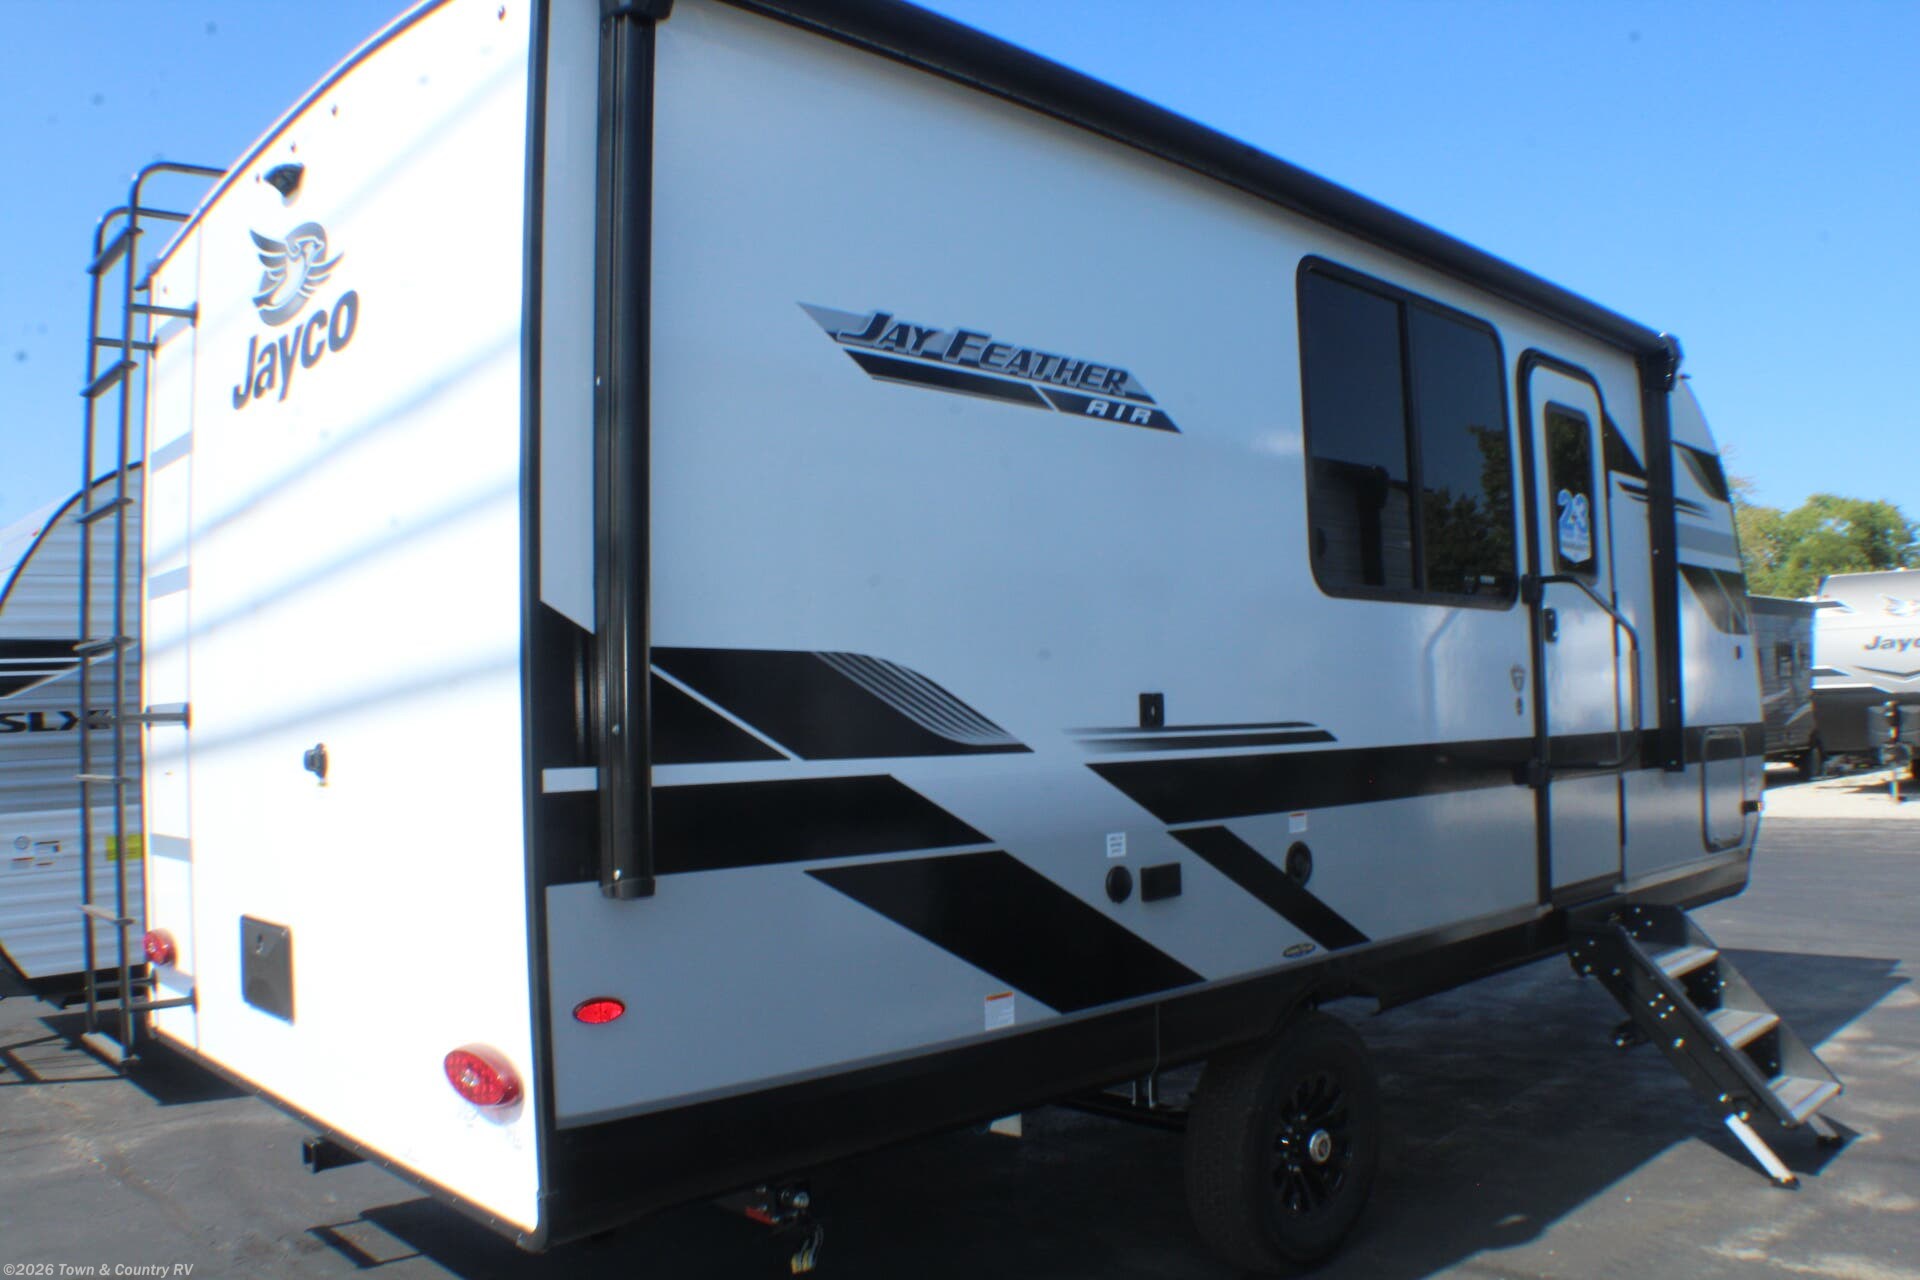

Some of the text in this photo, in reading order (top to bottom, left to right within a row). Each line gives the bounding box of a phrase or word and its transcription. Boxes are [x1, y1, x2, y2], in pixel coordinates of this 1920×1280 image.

[232, 289, 359, 410] Jayco
[837, 311, 1129, 394] JAY FEATHER
[1086, 399, 1152, 424] AIR
